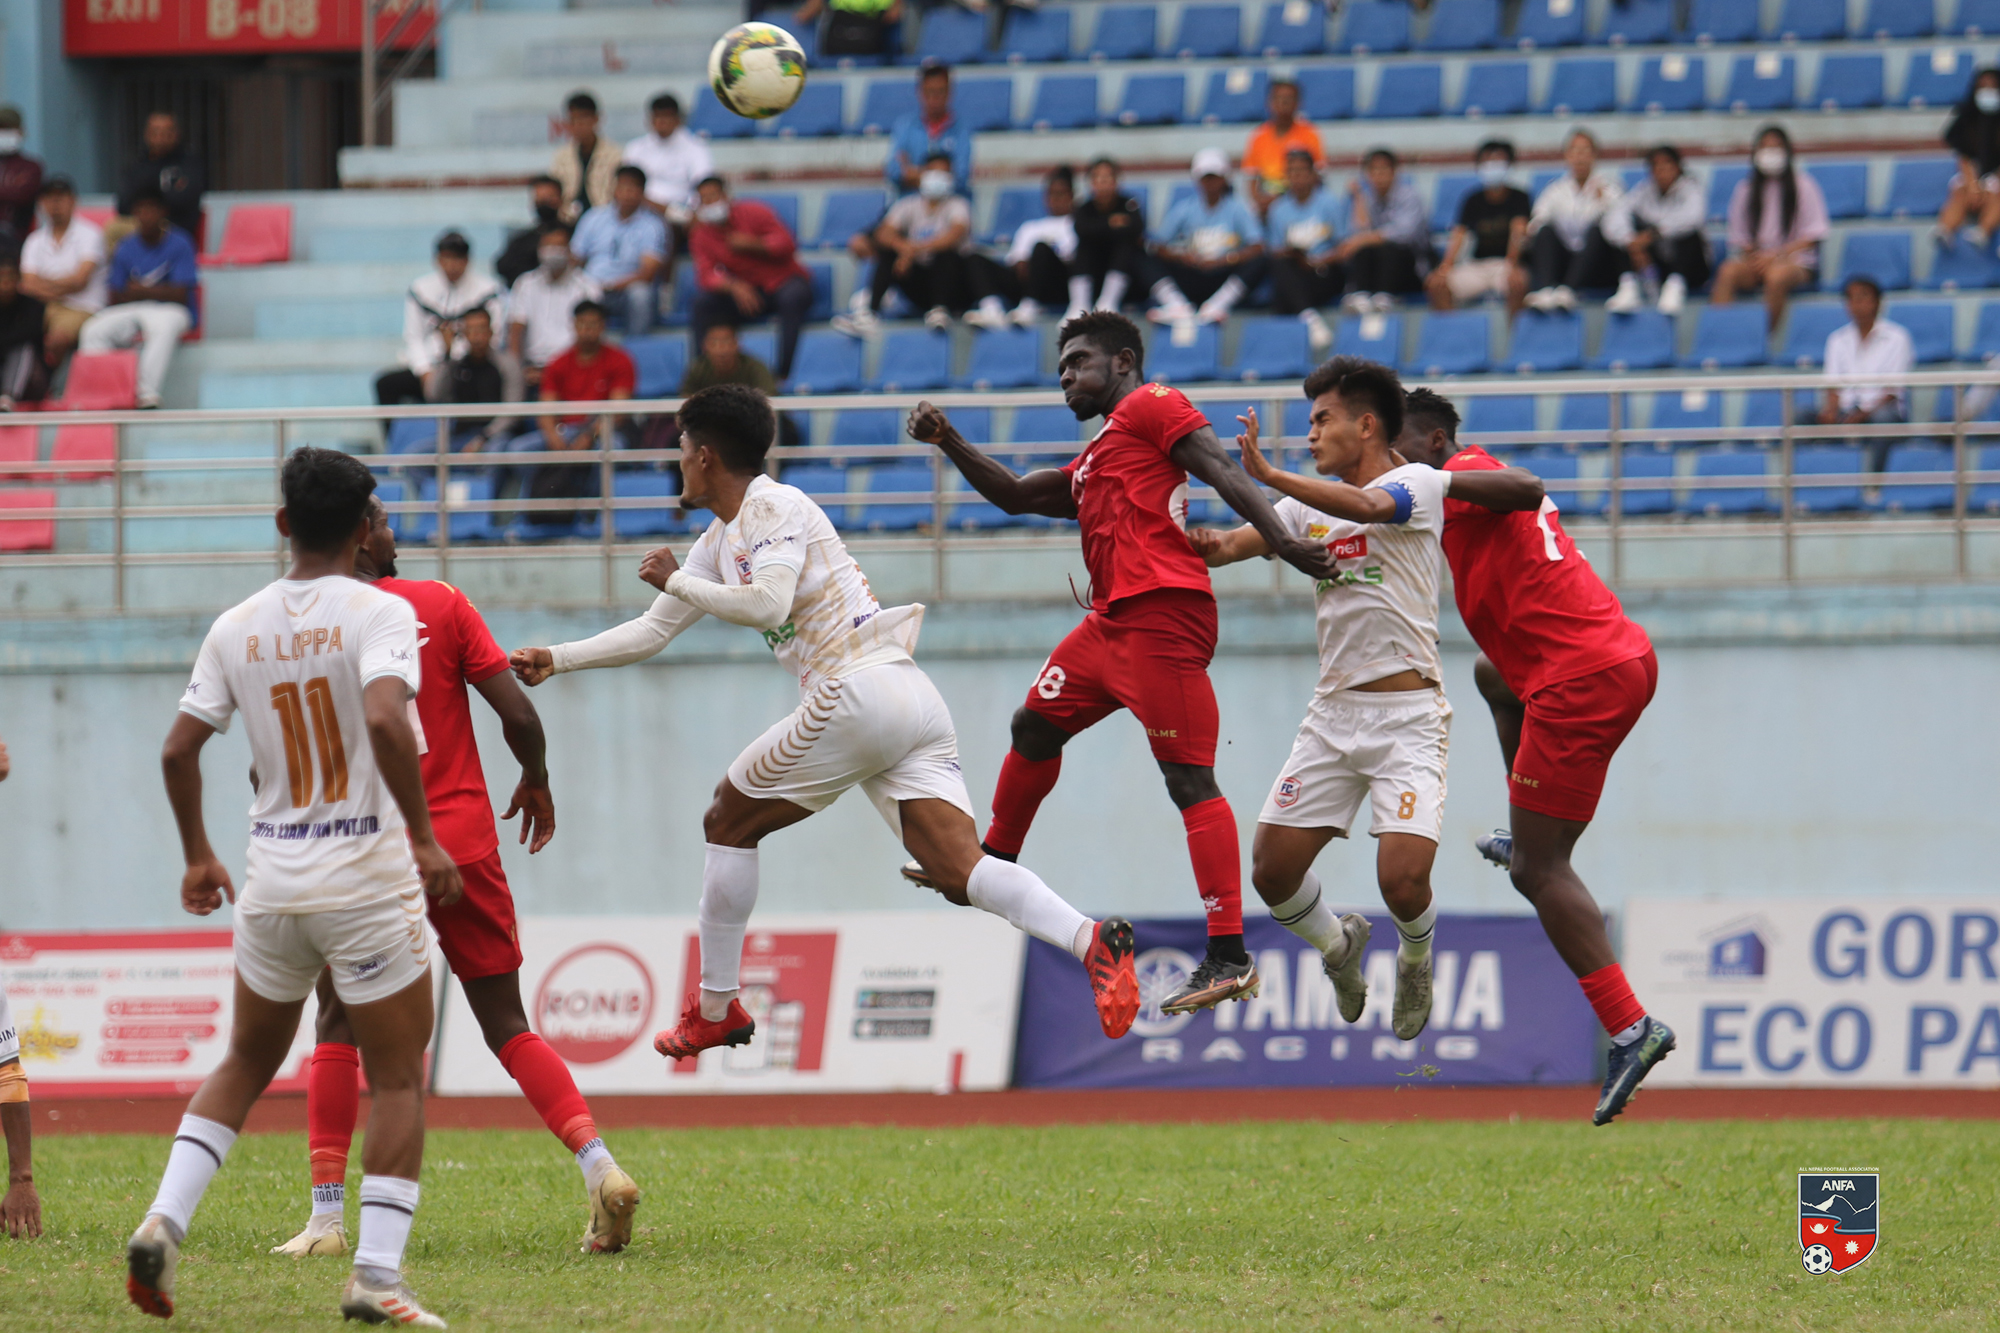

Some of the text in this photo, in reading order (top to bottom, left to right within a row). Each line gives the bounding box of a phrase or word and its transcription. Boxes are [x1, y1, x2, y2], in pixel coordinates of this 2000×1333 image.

[269, 676, 349, 809] 11
[1397, 791, 1417, 820] 8
[1141, 1036, 1480, 1063] RACING
[1697, 1004, 2000, 1075] ECO PA
